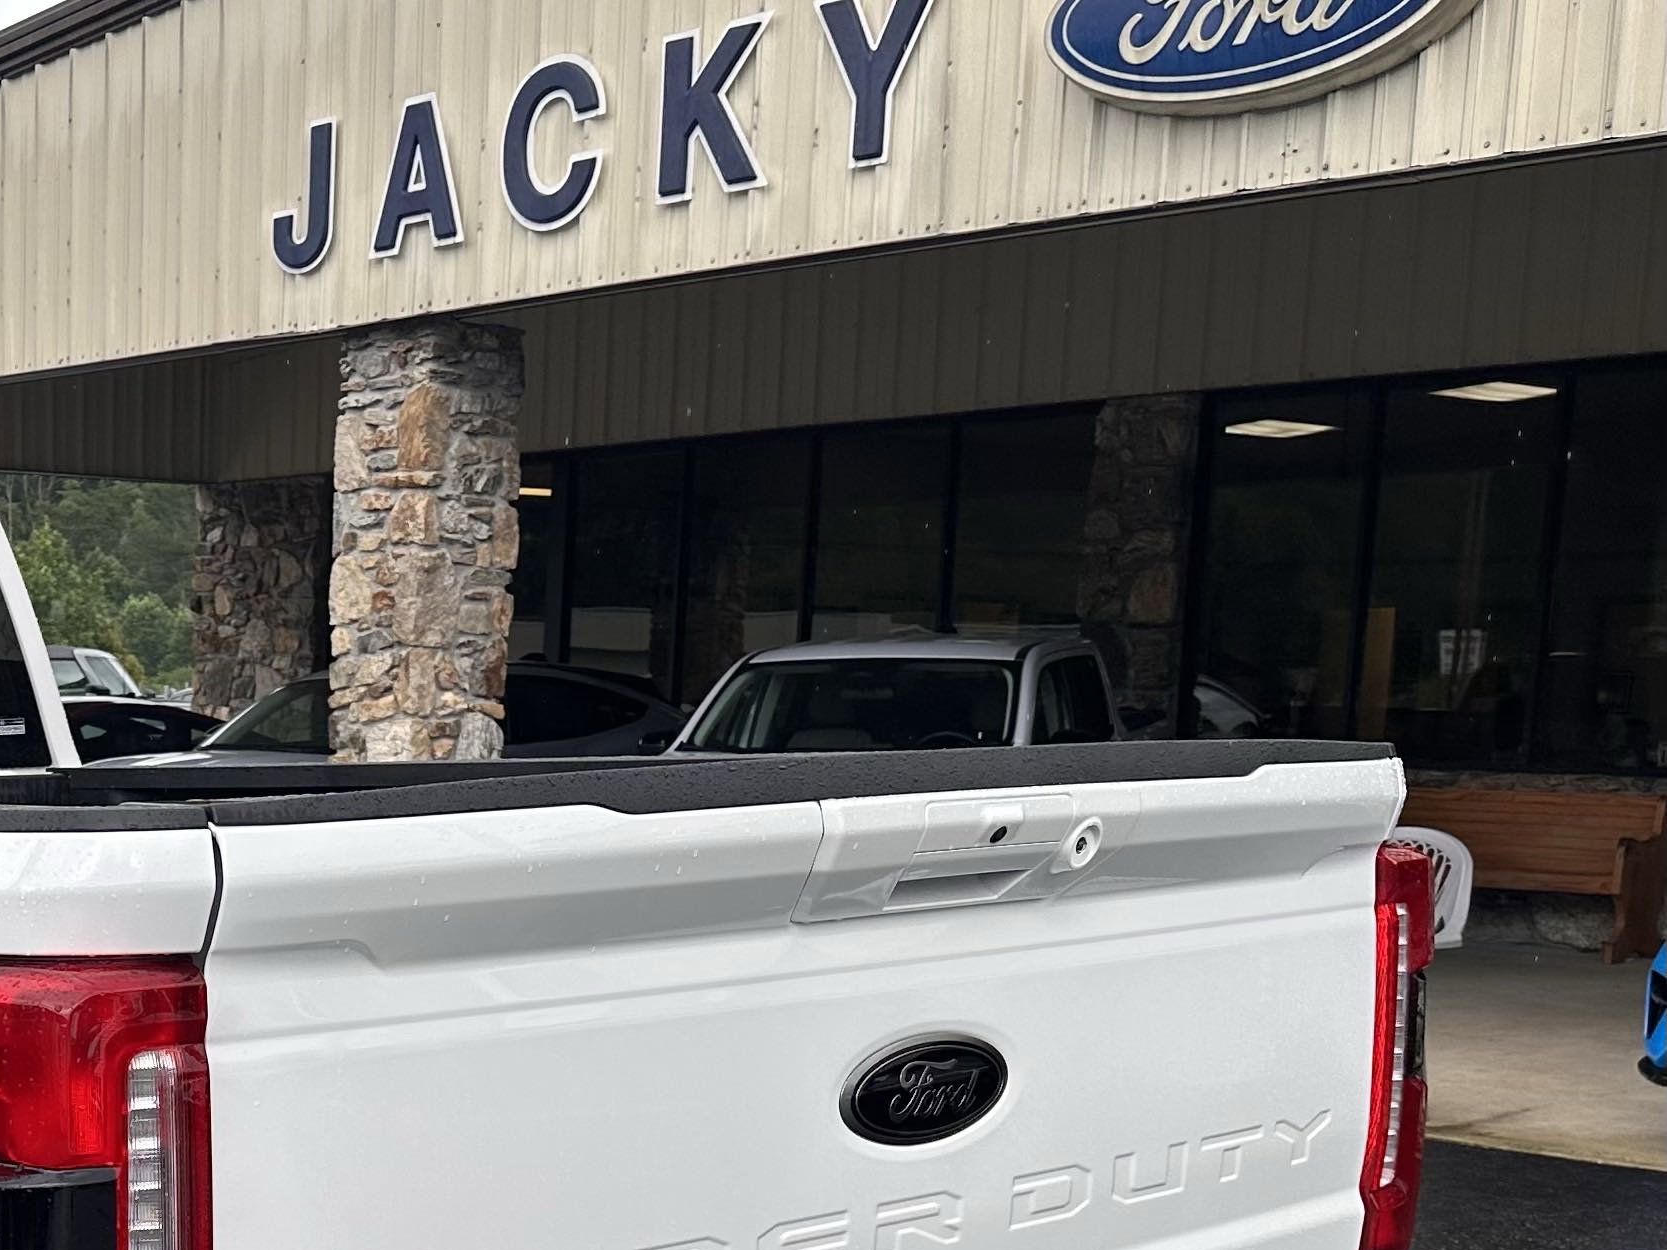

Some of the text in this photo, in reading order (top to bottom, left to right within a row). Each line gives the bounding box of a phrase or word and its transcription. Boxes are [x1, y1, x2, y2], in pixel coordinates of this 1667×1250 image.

[272, 0, 932, 274] JACKY
[889, 1058, 980, 1124] Ford
[1009, 1108, 1331, 1231] DUTY
